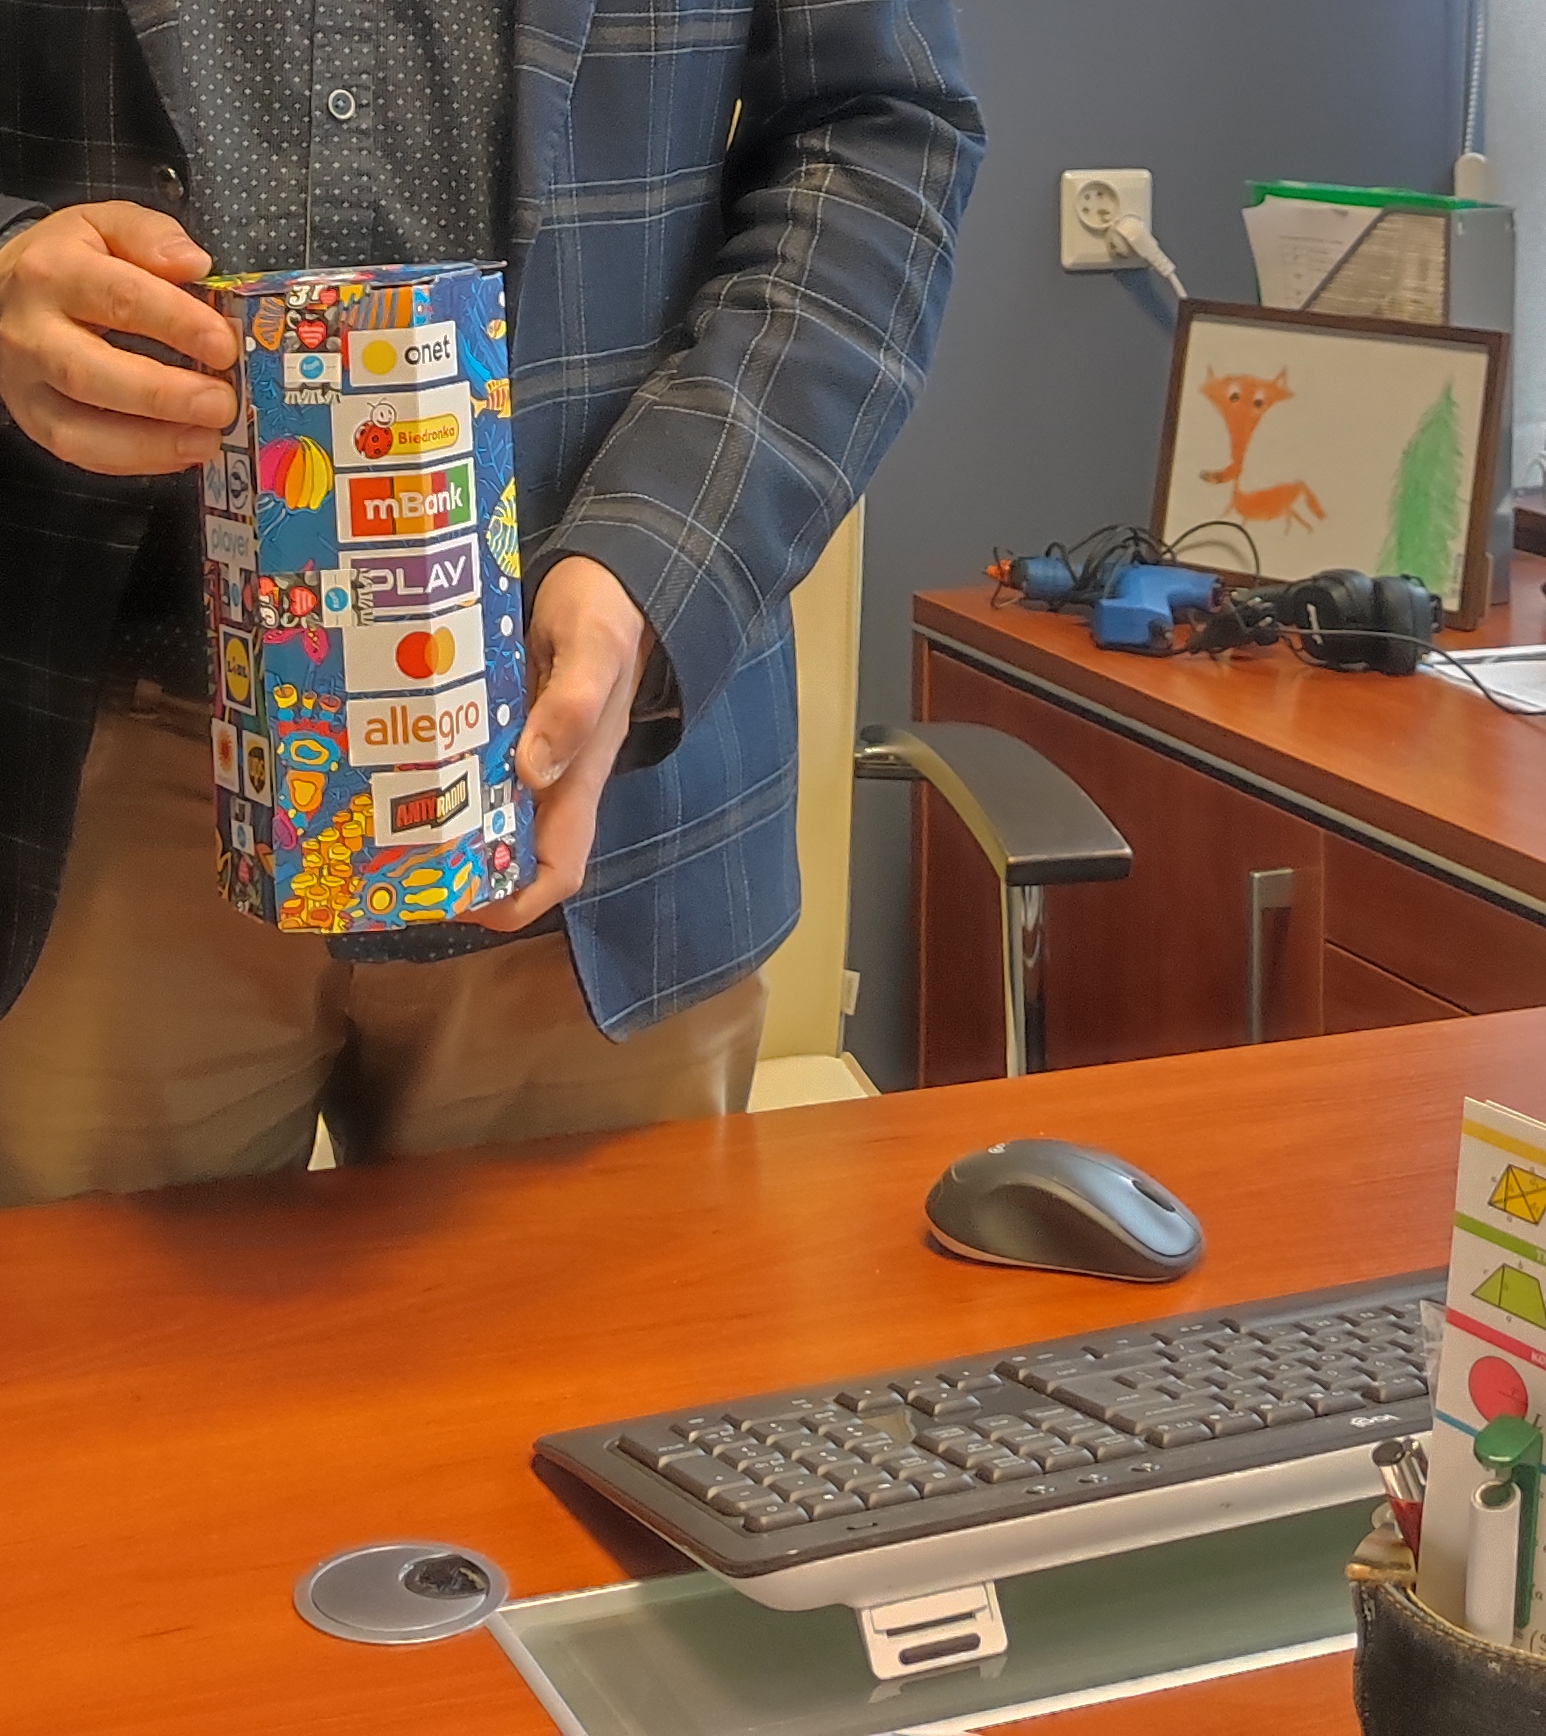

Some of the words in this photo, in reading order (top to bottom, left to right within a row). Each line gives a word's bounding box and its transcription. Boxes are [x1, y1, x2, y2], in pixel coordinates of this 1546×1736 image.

[404, 334, 452, 366] onet
[397, 425, 456, 446] Biedronka
[363, 481, 464, 521] mBank
[211, 524, 250, 560] player
[359, 555, 467, 596] PLAY
[364, 700, 480, 751] allegro
